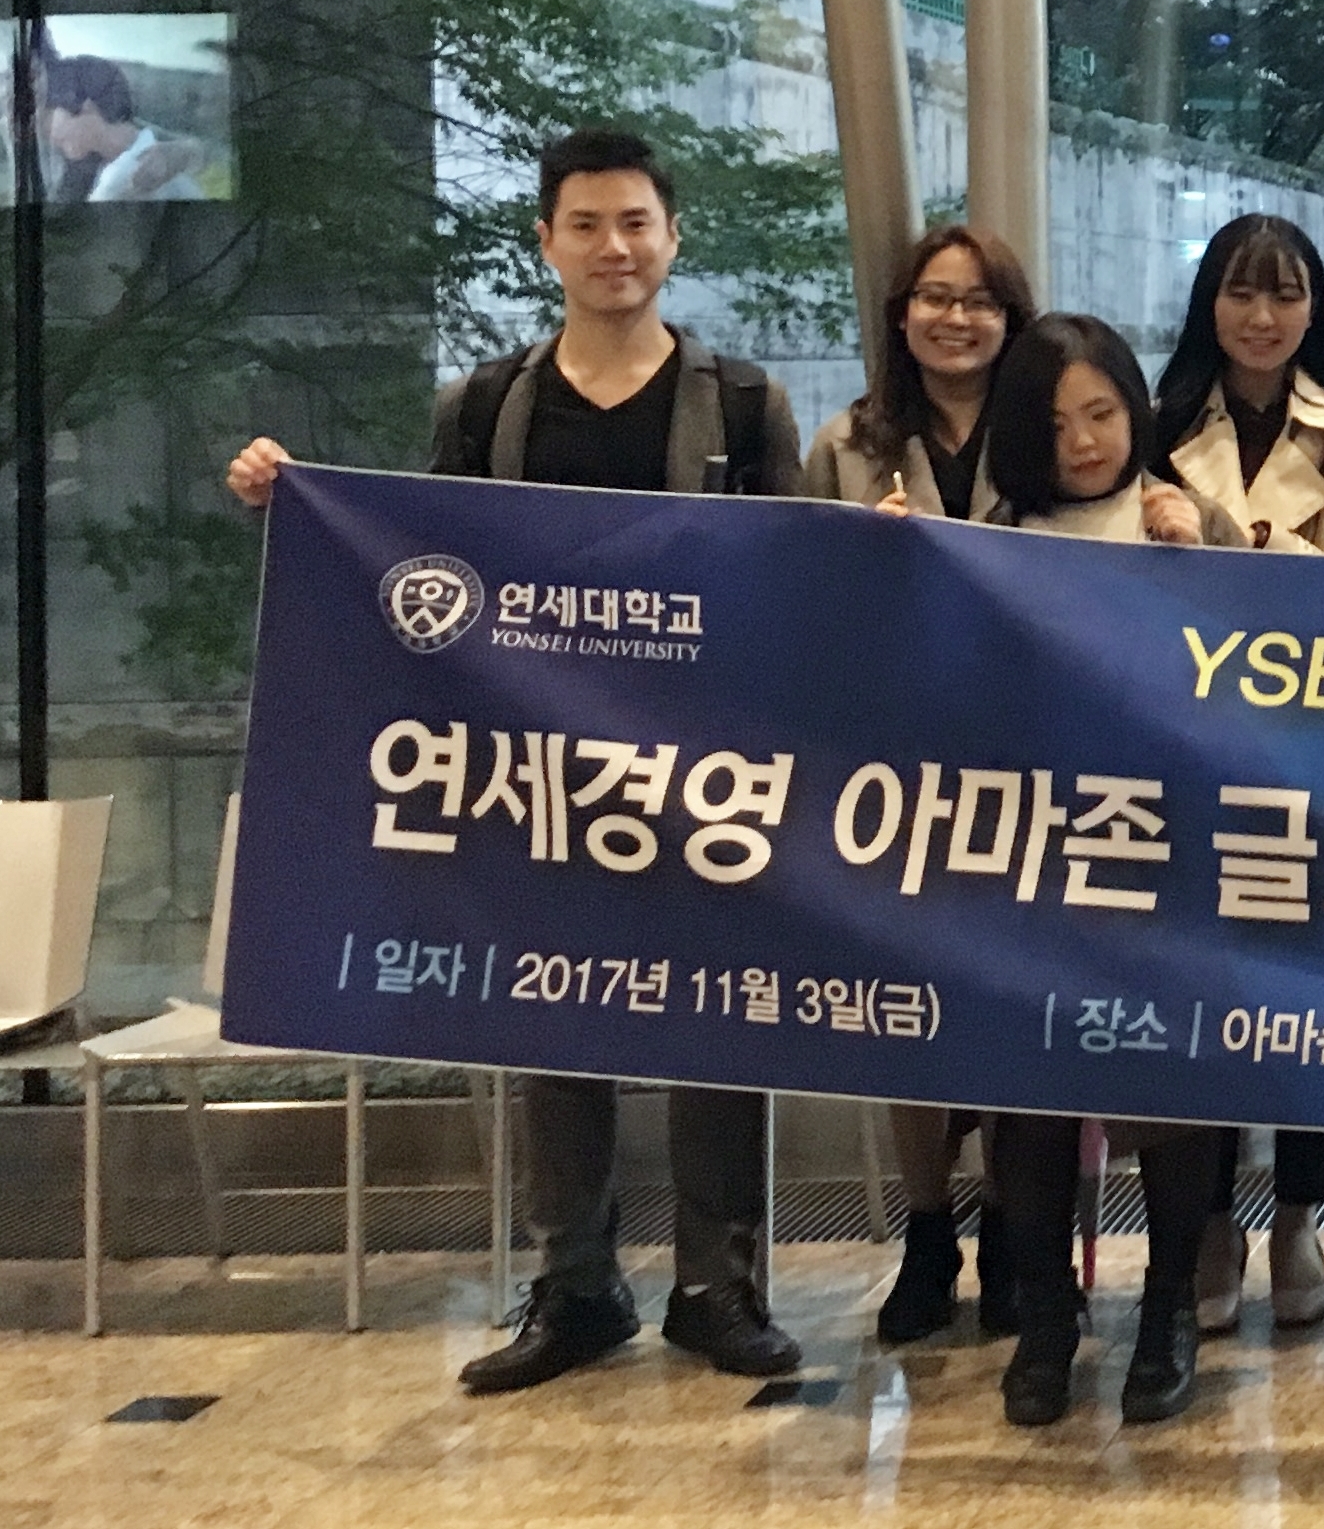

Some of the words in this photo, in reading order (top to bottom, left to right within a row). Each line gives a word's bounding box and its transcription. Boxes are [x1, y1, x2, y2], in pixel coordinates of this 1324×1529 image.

[489, 627, 573, 653] YONSEI
[577, 636, 703, 663] UNIVERSITY
[498, 581, 704, 635] 연세대학교
[368, 717, 795, 885] 연세경영
[832, 758, 1174, 912] 아마존
[374, 938, 467, 1000] 일자
[510, 952, 669, 1015] 2017년
[688, 966, 782, 1026] 11월
[795, 977, 942, 1041] 3일(금)
[1075, 997, 1170, 1055] 장소
